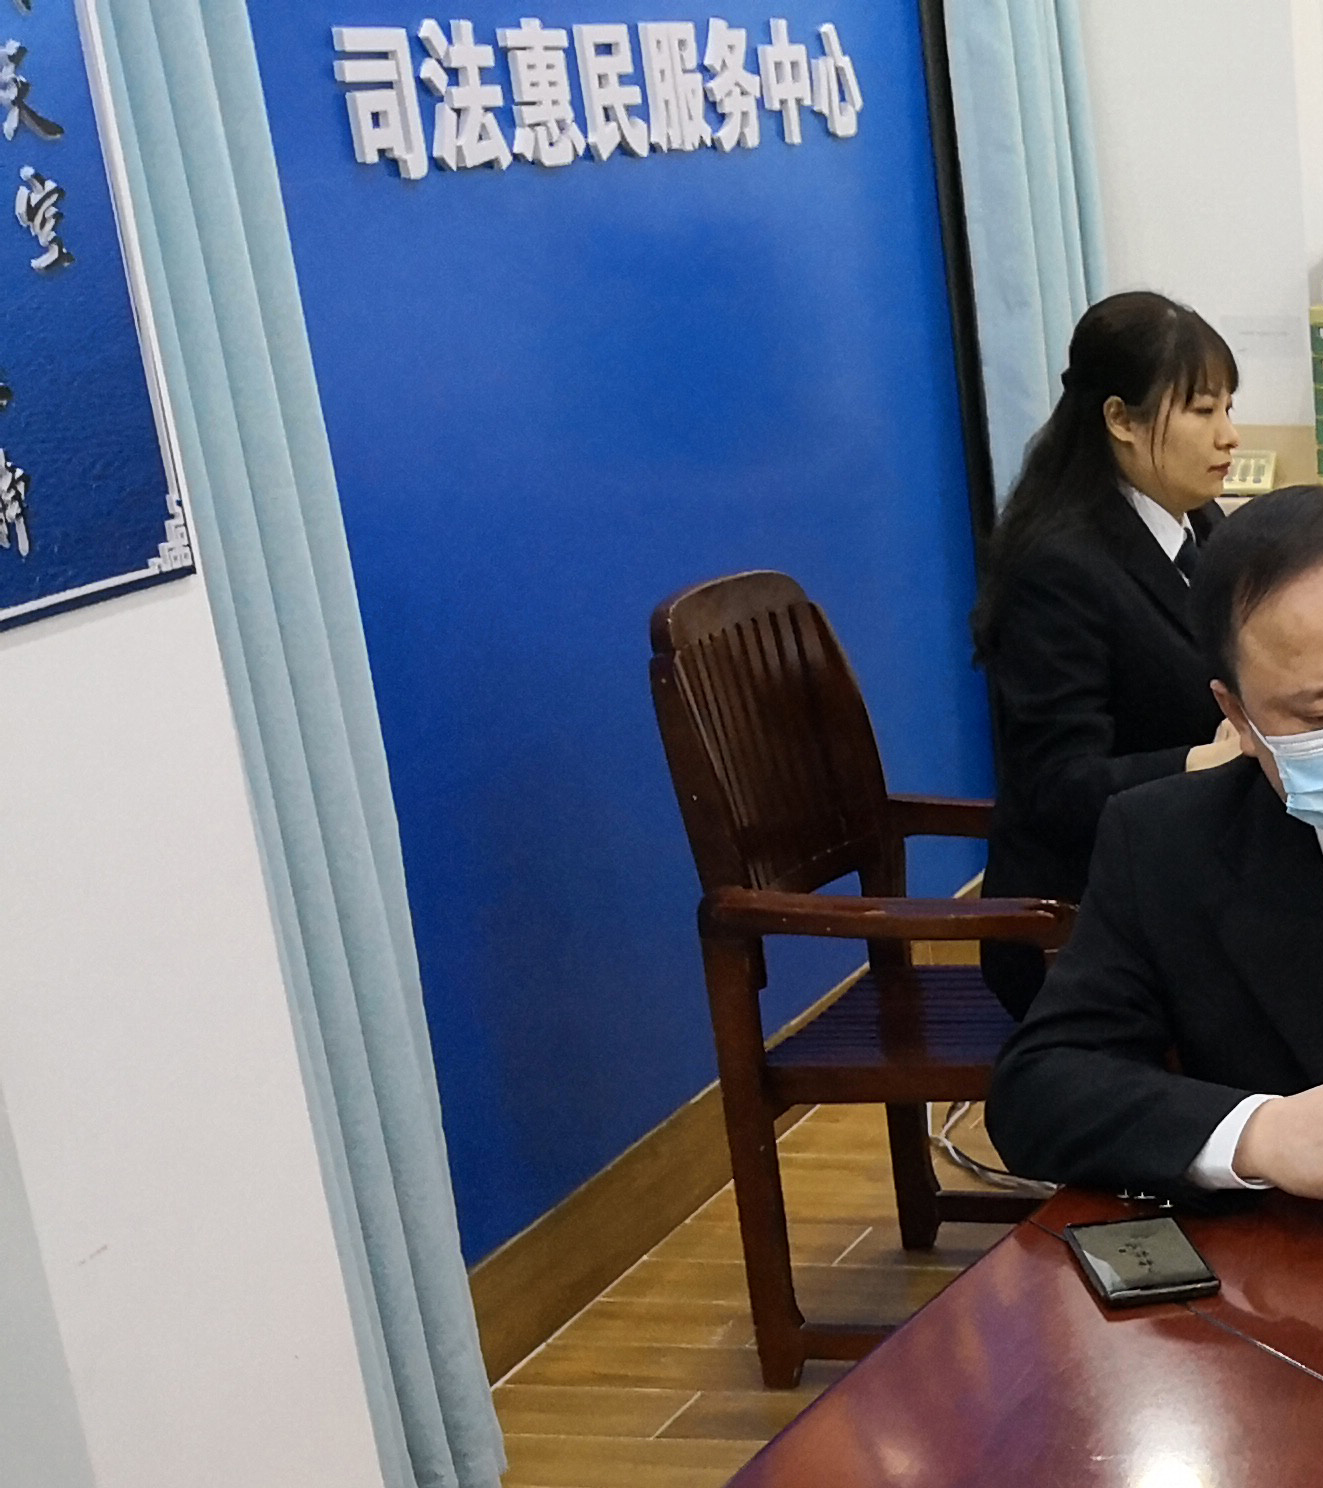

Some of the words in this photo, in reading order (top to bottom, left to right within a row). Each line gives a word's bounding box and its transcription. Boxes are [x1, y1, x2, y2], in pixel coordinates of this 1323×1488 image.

[332, 17, 863, 180] 司法惠民服务中心
